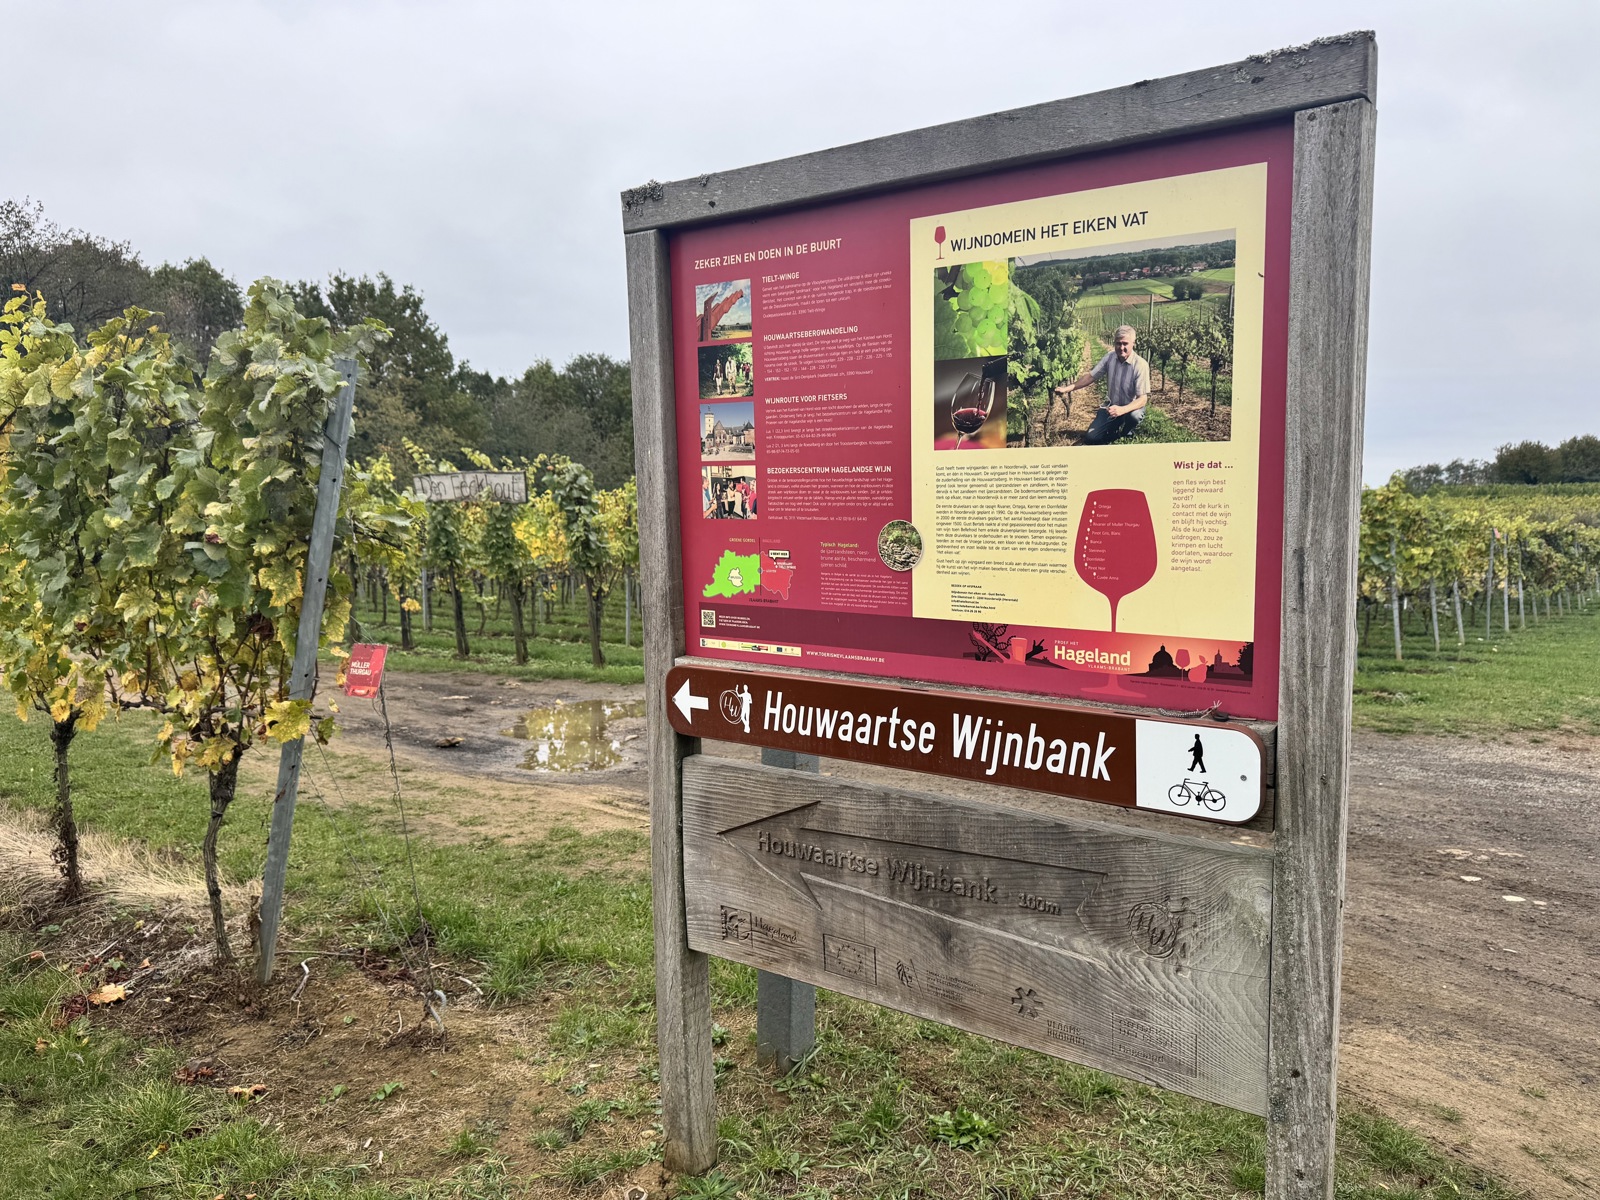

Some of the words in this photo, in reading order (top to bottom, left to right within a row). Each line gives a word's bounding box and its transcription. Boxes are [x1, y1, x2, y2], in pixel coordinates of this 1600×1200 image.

[950, 228, 1036, 251] WIJNDOMEIN
[1041, 223, 1068, 239] HET
[1073, 216, 1117, 234] EIKEN
[1122, 211, 1148, 227] VAT
[694, 257, 721, 270] ZEKER
[722, 254, 742, 265] ZIEN
[744, 252, 756, 262] EN
[758, 248, 782, 260] DOEN
[784, 246, 793, 256] IN
[796, 243, 808, 255] DE
[810, 238, 841, 252] BUURT
[762, 272, 800, 283] TIELT-WINGE
[763, 326, 858, 341] HOUWAARTSEBERGWANDELING
[1173, 461, 1194, 469] Wist
[1054, 645, 1130, 666] Hageland
[764, 690, 936, 754] Houwaartse
[952, 713, 1116, 782] Wijnbank
[758, 830, 879, 876] Houwaartse
[884, 856, 998, 905] Wijnbank
[1018, 892, 1062, 916] 100m
